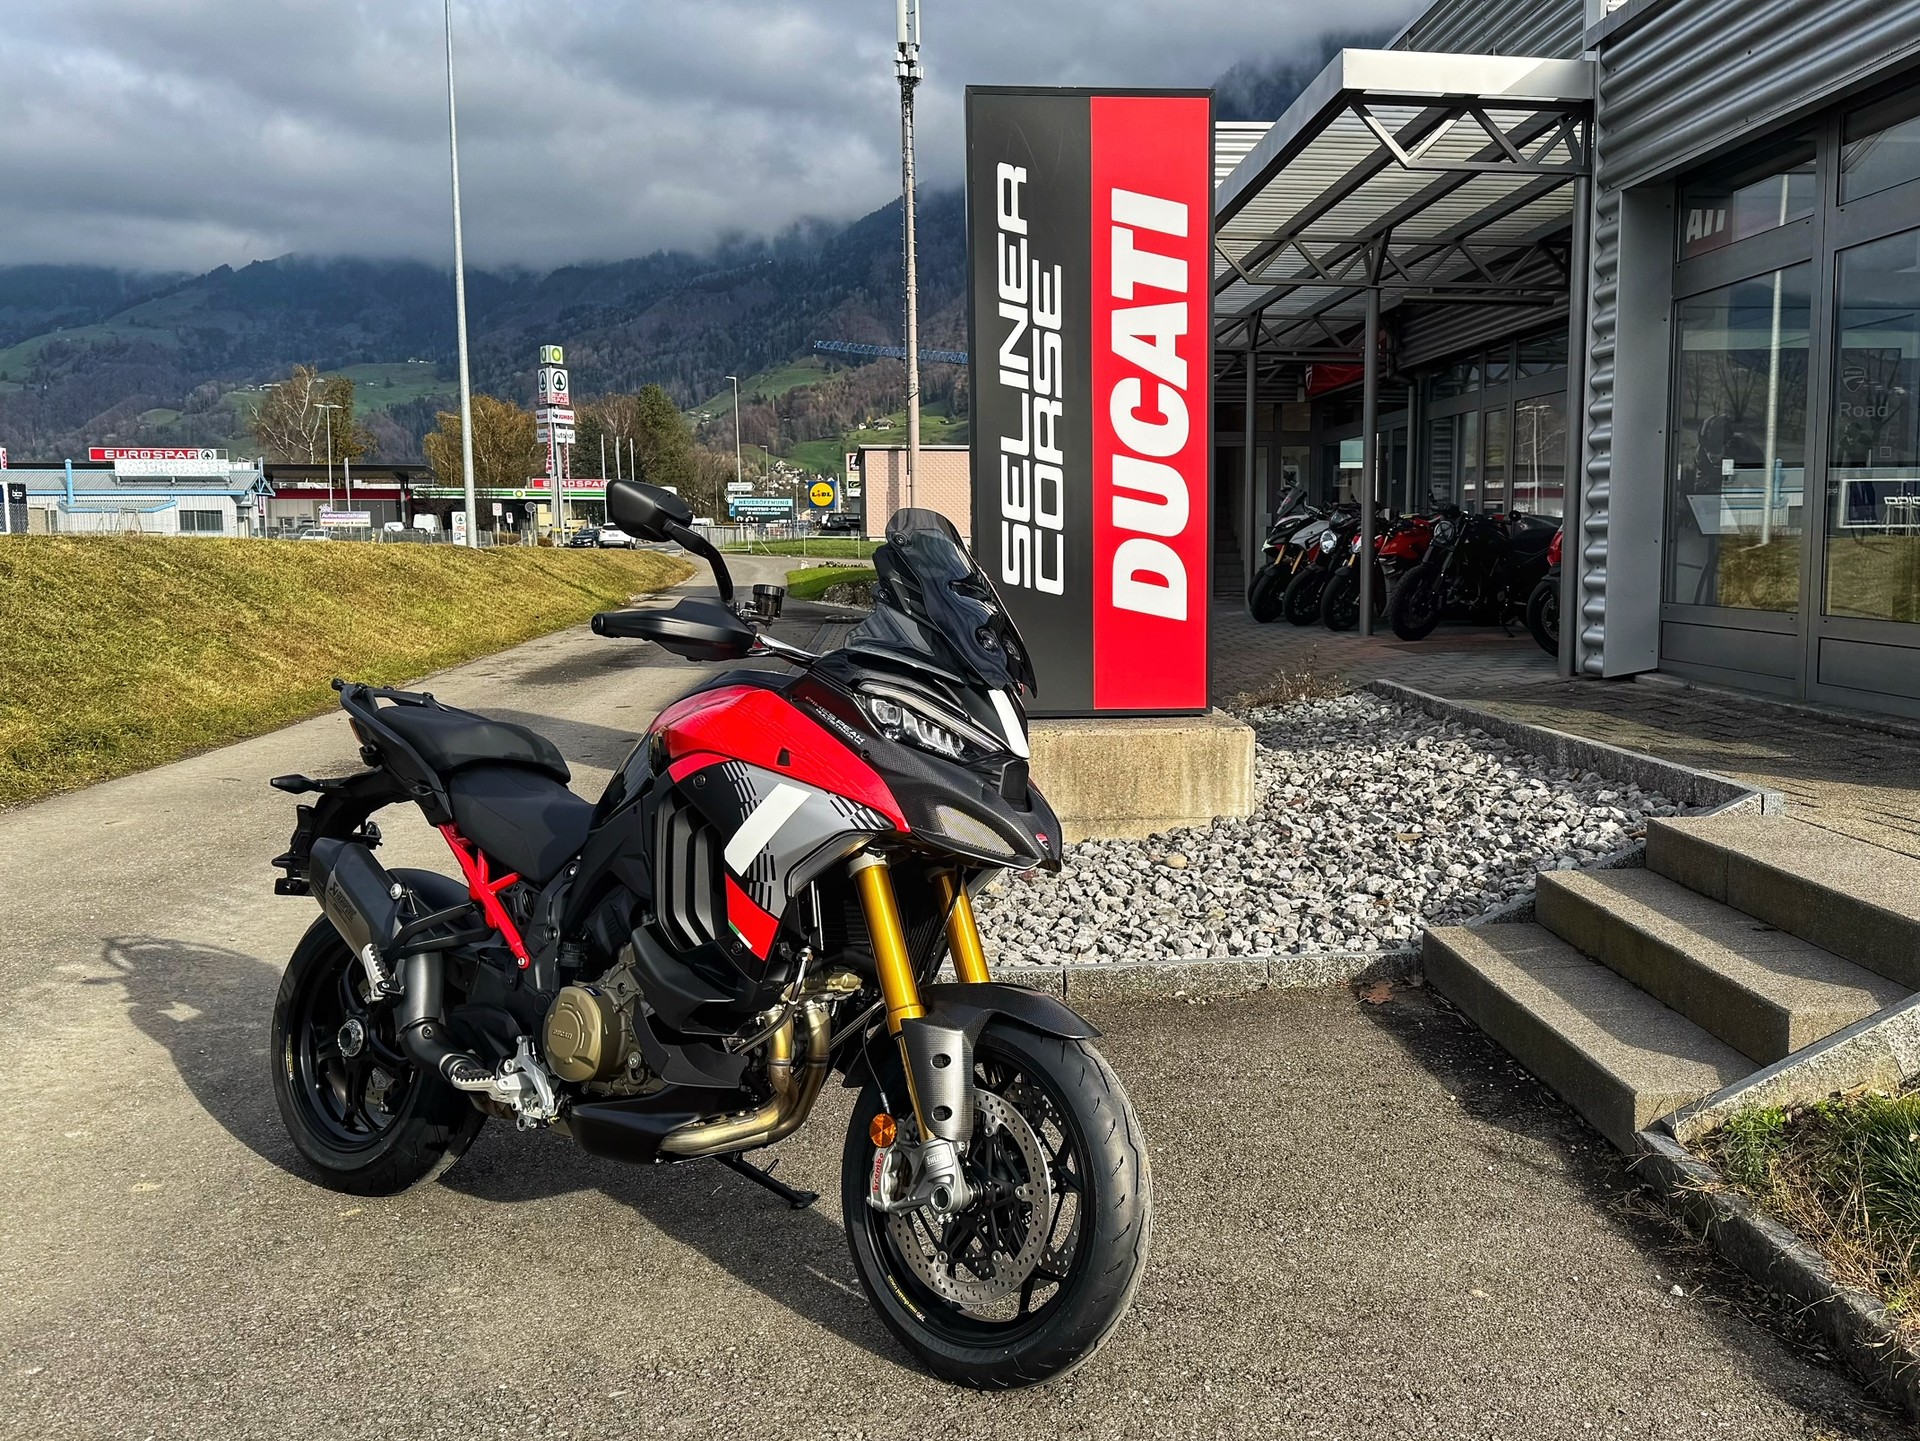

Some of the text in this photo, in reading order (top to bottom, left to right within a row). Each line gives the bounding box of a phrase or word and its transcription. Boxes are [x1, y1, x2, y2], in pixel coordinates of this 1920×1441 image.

[995, 161, 1031, 590] SELINER
[1109, 186, 1191, 622] DUCATI
[1839, 402, 1890, 418] Road
[1031, 257, 1065, 597] CORSE
[104, 450, 198, 459] EUROSPAR
[835, 719, 866, 743] PEAK
[872, 1152, 885, 1192] brembo
